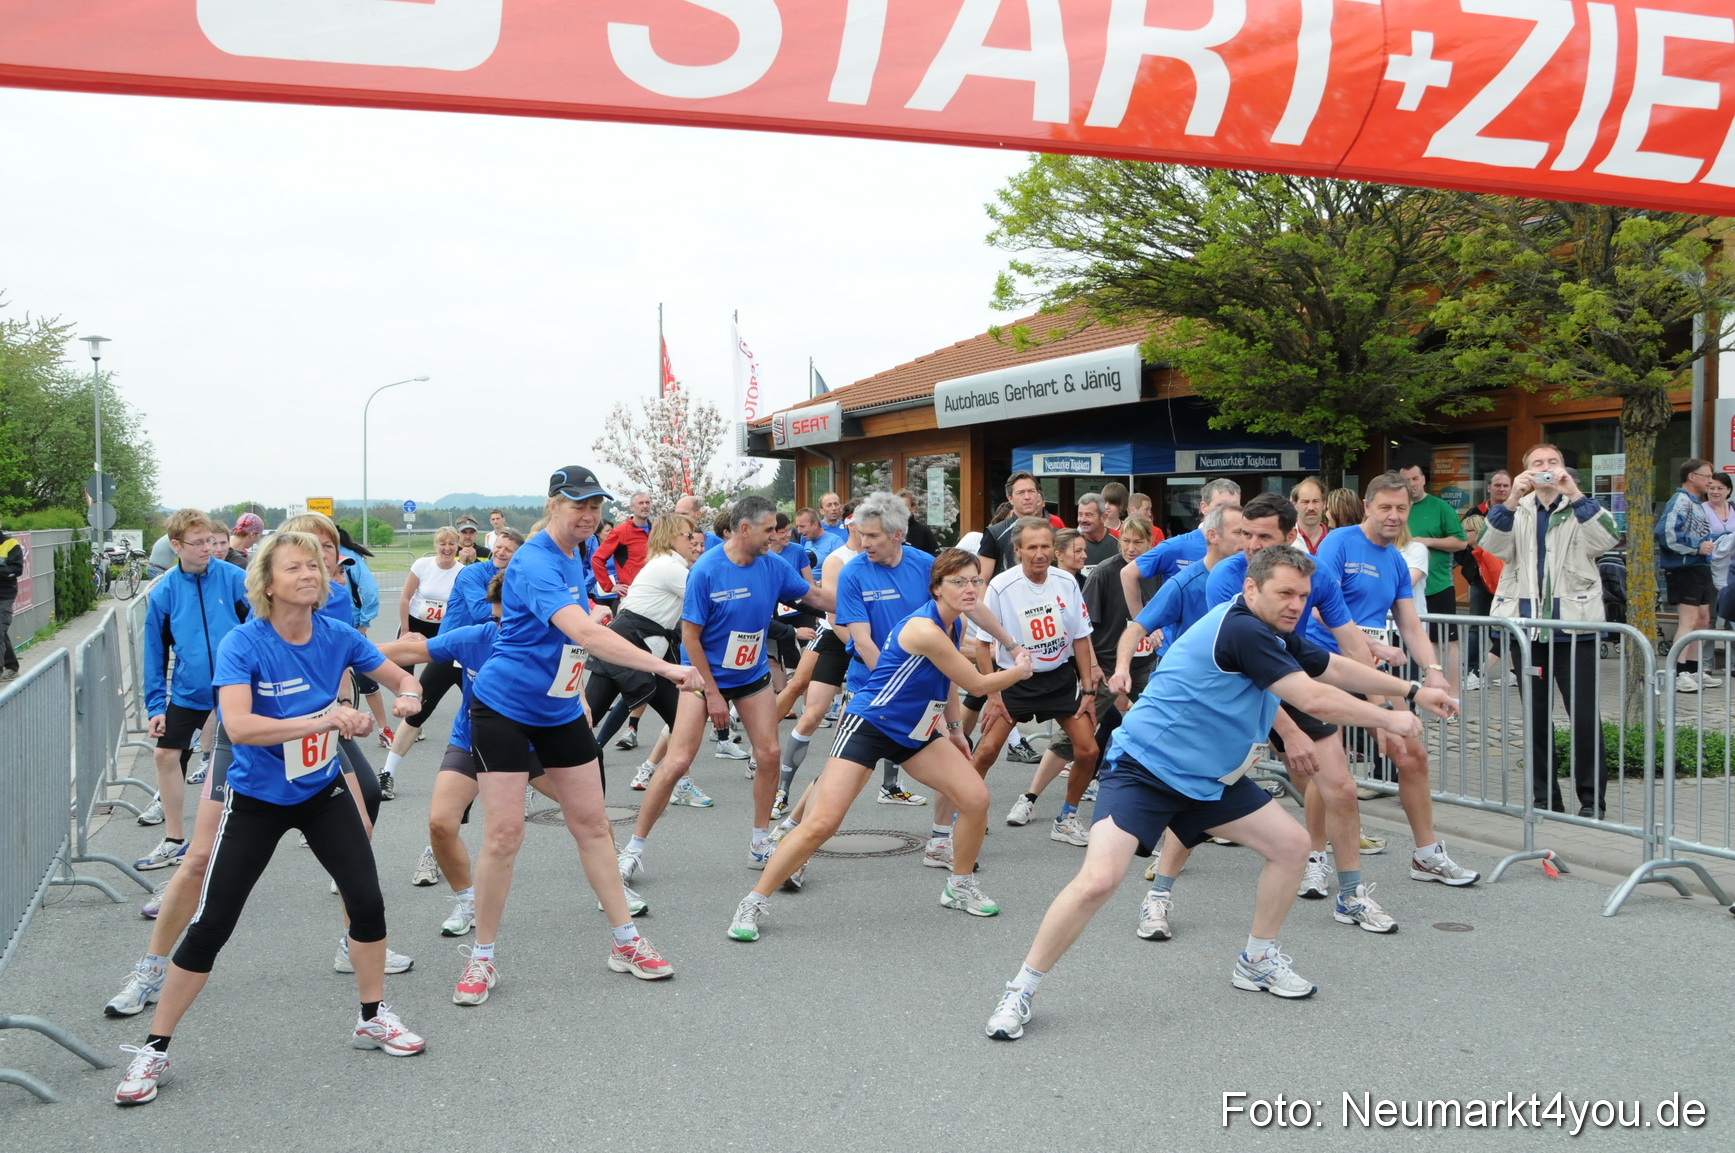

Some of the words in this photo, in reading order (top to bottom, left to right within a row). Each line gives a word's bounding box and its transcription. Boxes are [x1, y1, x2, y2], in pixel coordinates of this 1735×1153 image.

[944, 391, 999, 412] Autohaus
[1004, 379, 1059, 402] Gerhart
[1064, 373, 1075, 393] &
[1081, 366, 1122, 392] Jänig
[791, 415, 829, 435] SEAT
[1200, 456, 1245, 467] Neumarkter
[1246, 455, 1278, 468] Tagblatt
[426, 607, 442, 620] 24
[1024, 606, 1043, 615] MEYER
[1030, 615, 1056, 641] 86
[734, 644, 758, 666] 64
[565, 662, 584, 691] 2
[301, 731, 330, 768] 67
